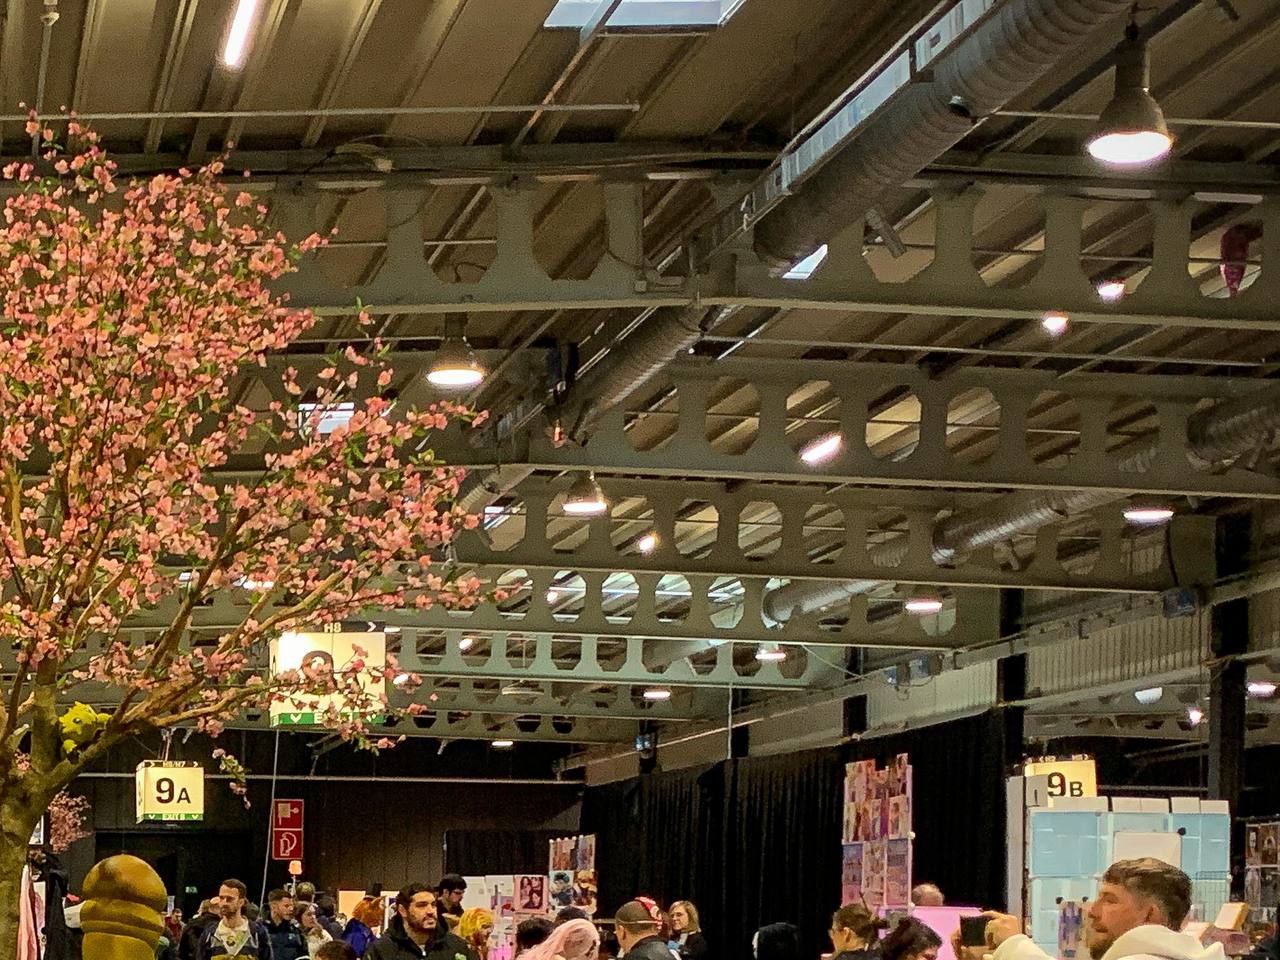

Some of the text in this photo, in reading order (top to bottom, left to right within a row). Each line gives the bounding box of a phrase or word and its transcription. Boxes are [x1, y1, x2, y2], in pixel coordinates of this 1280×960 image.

[323, 622, 342, 633] H8
[156, 777, 191, 804] 9A
[1047, 771, 1084, 797] 9B
